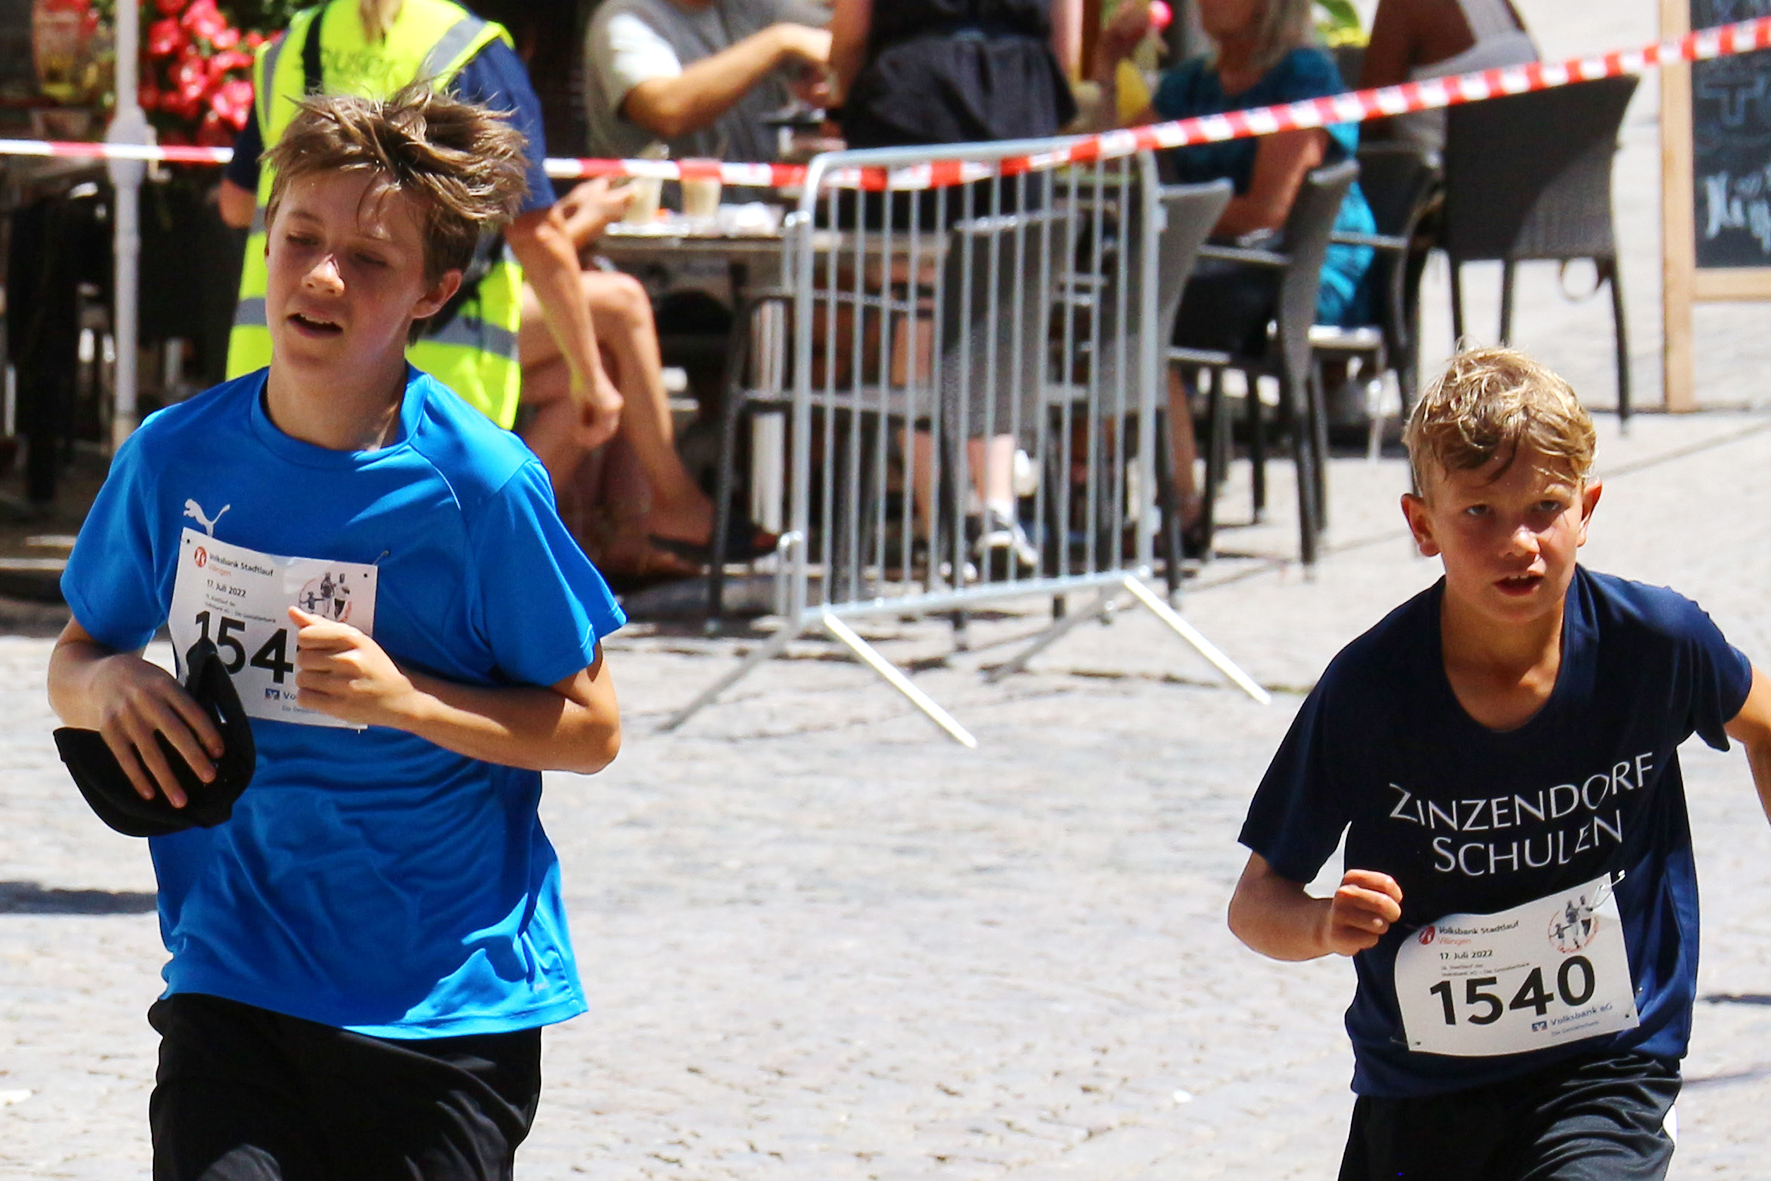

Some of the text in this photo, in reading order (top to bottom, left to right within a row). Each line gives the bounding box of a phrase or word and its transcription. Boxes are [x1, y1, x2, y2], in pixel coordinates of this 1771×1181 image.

[229, 586, 247, 598] 2022
[195, 611, 300, 684] 154
[1389, 752, 1653, 831] ZINZENDORF
[1433, 809, 1623, 877] SCHULEN
[1439, 920, 1519, 935] Volksbank Stadtlauf
[1471, 949, 1493, 959] 2022
[1430, 955, 1595, 1026] 1540
[1550, 1007, 1597, 1026] Volksbank
